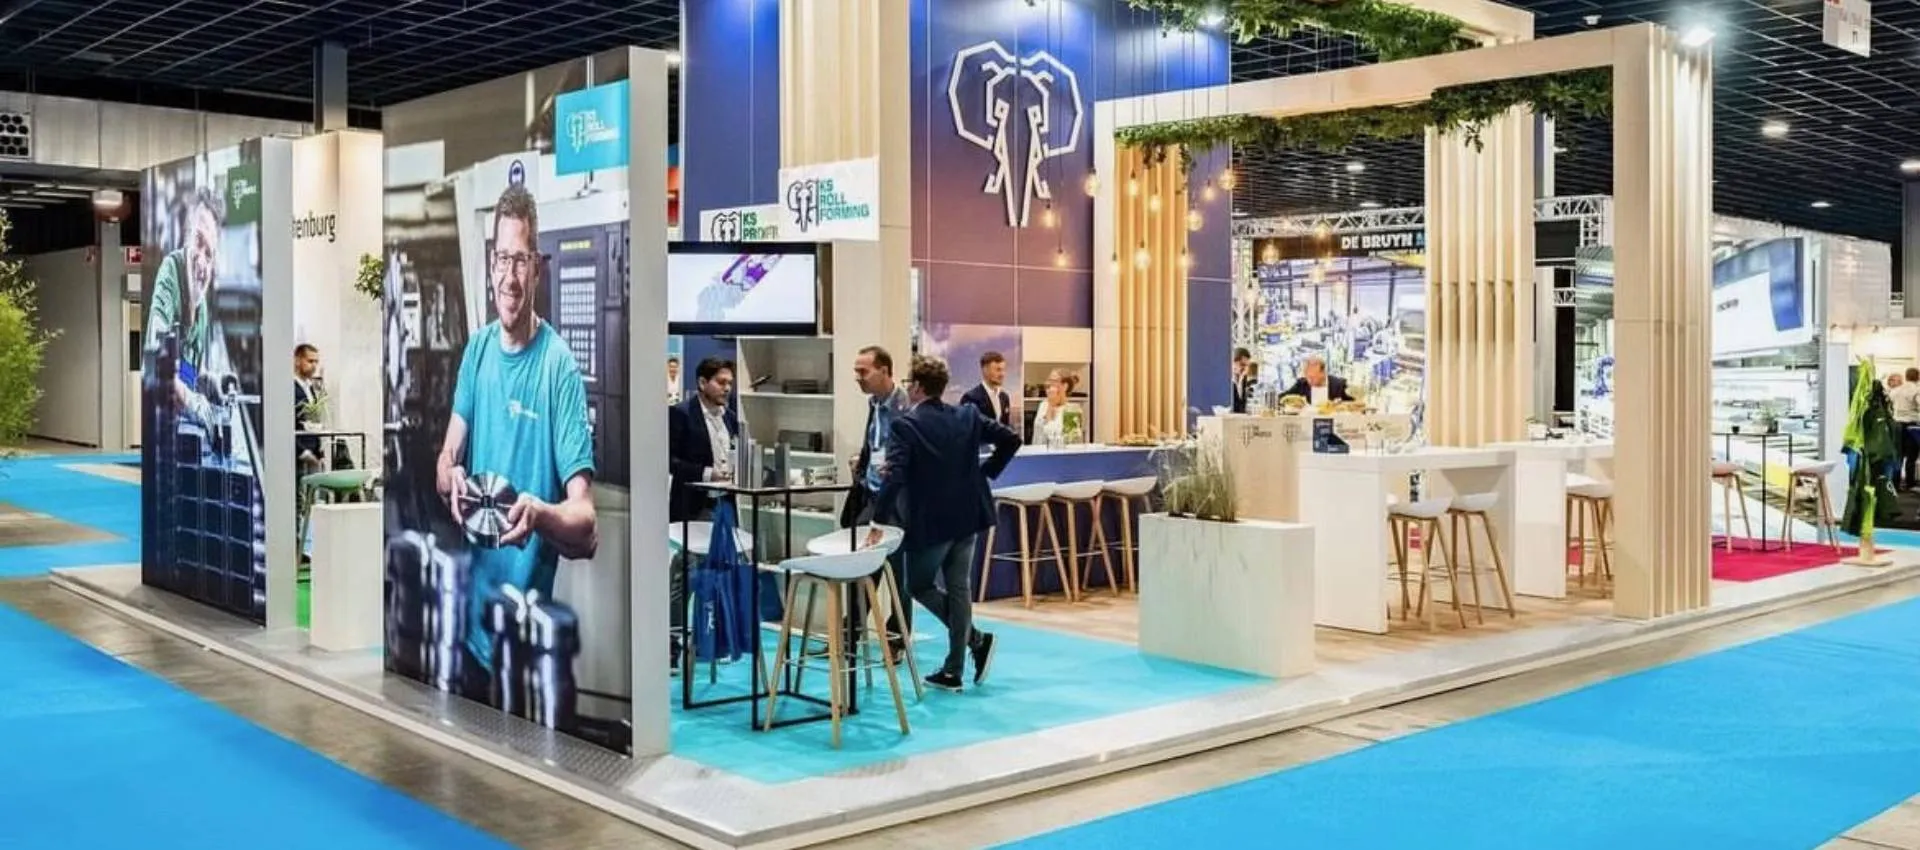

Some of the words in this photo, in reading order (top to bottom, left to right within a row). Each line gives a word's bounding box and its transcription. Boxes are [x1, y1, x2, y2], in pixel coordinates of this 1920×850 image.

[820, 178, 833, 191] KS
[820, 191, 847, 206] ROLL
[743, 212, 757, 226] KS
[820, 203, 869, 221] FORMING
[1341, 235, 1360, 250] DE
[1362, 232, 1414, 249] BRUYN
